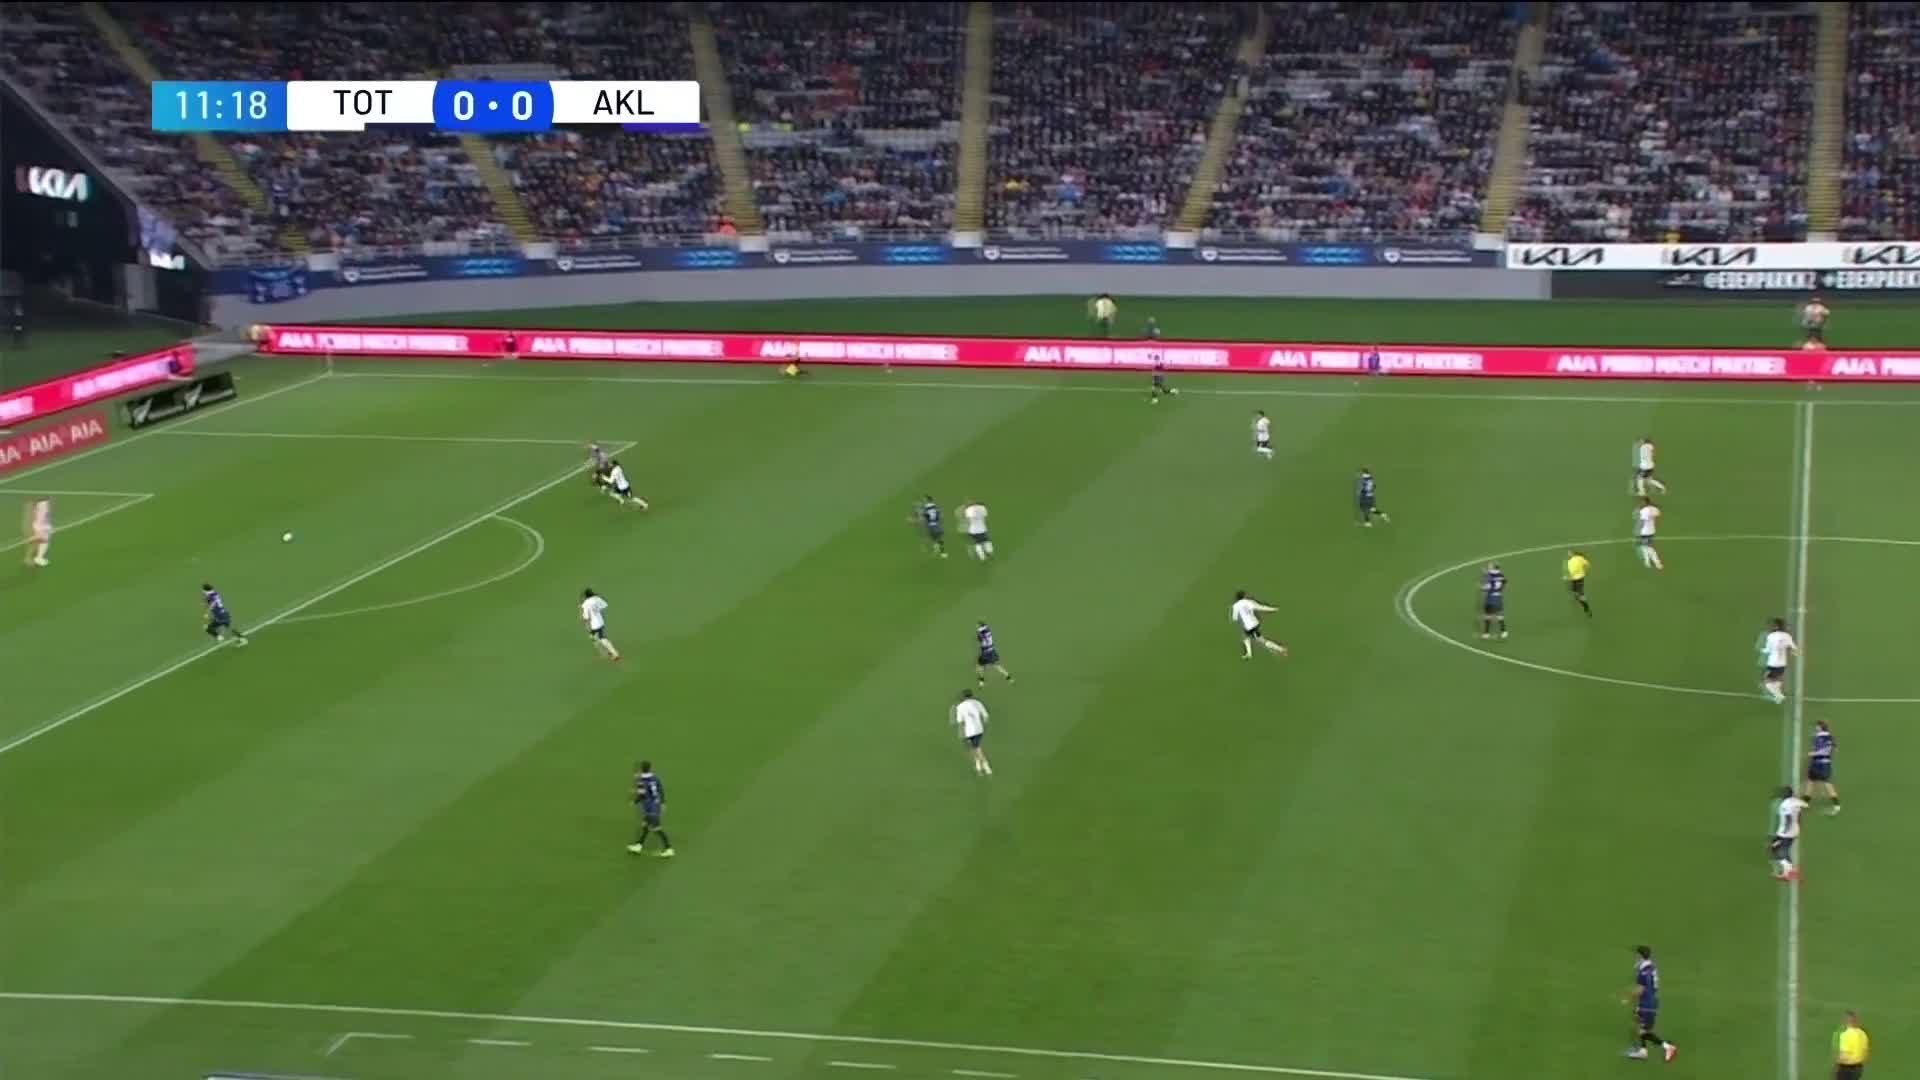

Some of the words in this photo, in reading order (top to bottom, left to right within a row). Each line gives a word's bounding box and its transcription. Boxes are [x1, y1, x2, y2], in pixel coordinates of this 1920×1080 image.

[1522, 247, 1605, 266] KIA
[1671, 247, 1757, 266] KIA
[1269, 350, 1307, 367] AIA
[1557, 356, 1597, 372] AIA
[1832, 358, 1877, 374] AIA
[30, 431, 64, 456] AIA
[71, 419, 105, 444] AIA
